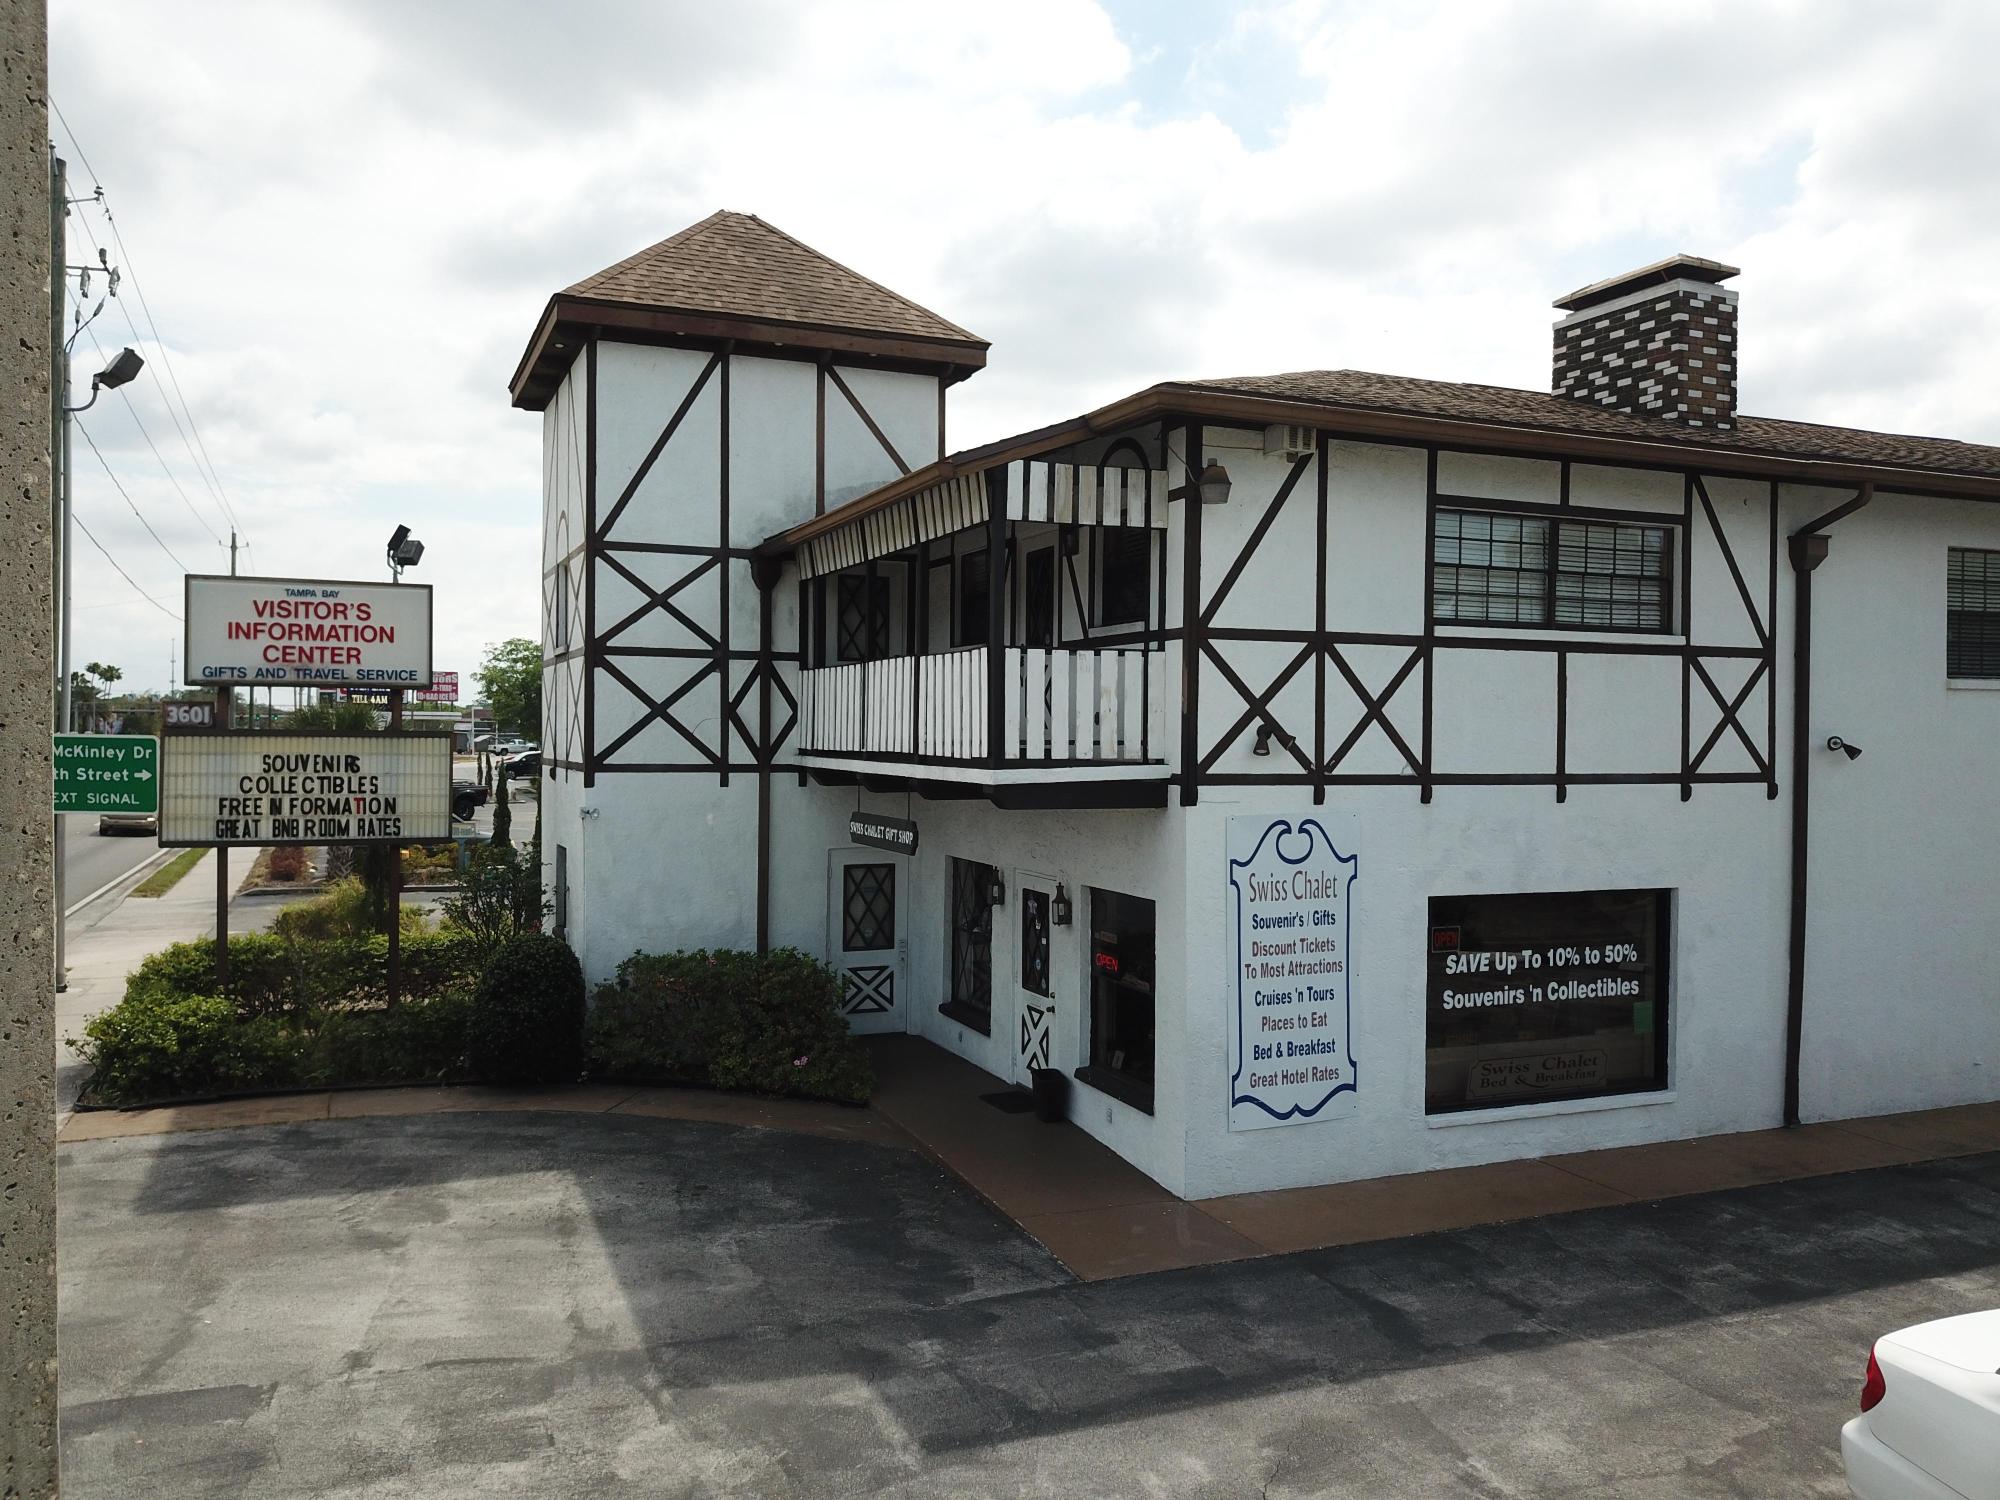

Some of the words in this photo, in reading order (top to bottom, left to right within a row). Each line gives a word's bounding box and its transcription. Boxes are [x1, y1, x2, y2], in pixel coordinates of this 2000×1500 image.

[285, 588, 317, 598] TAMPA
[321, 590, 340, 599] BAY
[252, 600, 372, 621] VISITOR'S
[227, 621, 395, 643] INFORMATION
[262, 645, 362, 665] CENTER
[202, 666, 247, 679] GIFTS
[255, 667, 287, 680] AND
[294, 668, 349, 680] TRAVEL
[356, 668, 418, 681] SERVICE
[351, 694, 368, 704] TILL
[167, 705, 211, 724] 3601
[53, 745, 125, 761] McKinley
[133, 746, 152, 759] Dr
[53, 767, 69, 781] th
[76, 767, 129, 782] Street
[239, 775, 379, 795] COLLECTIBLES
[53, 792, 78, 804] EXT
[87, 793, 140, 805] SIGNAL
[218, 797, 263, 816] FREE
[215, 818, 261, 838] GREAT
[272, 818, 300, 838] BNB
[303, 818, 350, 838] ROOM
[357, 817, 401, 837] RATES
[850, 821, 864, 835] SWISS
[864, 823, 885, 839] CHALET
[885, 827, 898, 842] GIFT
[898, 830, 914, 845] SHOP
[1249, 872, 1288, 903] Swiss
[1291, 870, 1338, 901] Chalet
[1252, 911, 1304, 930] Souvenir's
[1312, 909, 1336, 926] Gifts
[1252, 938, 1297, 957] Discount
[1300, 936, 1336, 954] Tickets
[1434, 931, 1458, 947] OPEN
[1095, 952, 1119, 973] OPEN
[1244, 964, 1257, 980] To
[1260, 962, 1285, 979] Most
[1287, 958, 1343, 977] Attractions
[1445, 952, 1490, 975] SAVE
[1494, 951, 1517, 975] Up
[1522, 950, 1542, 969] To
[1547, 946, 1580, 967] 10%
[1584, 948, 1600, 965] to
[1604, 943, 1638, 964] 50%
[1254, 989, 1292, 1007] Cruises
[1306, 985, 1335, 1002] Tours
[1442, 985, 1525, 1010] Souvenirs
[1547, 977, 1640, 1000] Collectibles
[1261, 1015, 1295, 1032] Places
[1298, 1013, 1308, 1029] to
[1311, 1011, 1328, 1028] Eat
[1253, 1043, 1272, 1061] Bed
[1275, 1042, 1284, 1059] &
[1287, 1037, 1336, 1057] Breakfast
[1480, 1062, 1530, 1077] Swiss
[1542, 1055, 1599, 1071] Chalet
[1250, 1071, 1279, 1089] Great
[1281, 1067, 1309, 1086] Hotel
[1311, 1065, 1340, 1083] Rates
[1480, 1076, 1507, 1089] Bed
[1536, 1069, 1597, 1083] Breakfast
